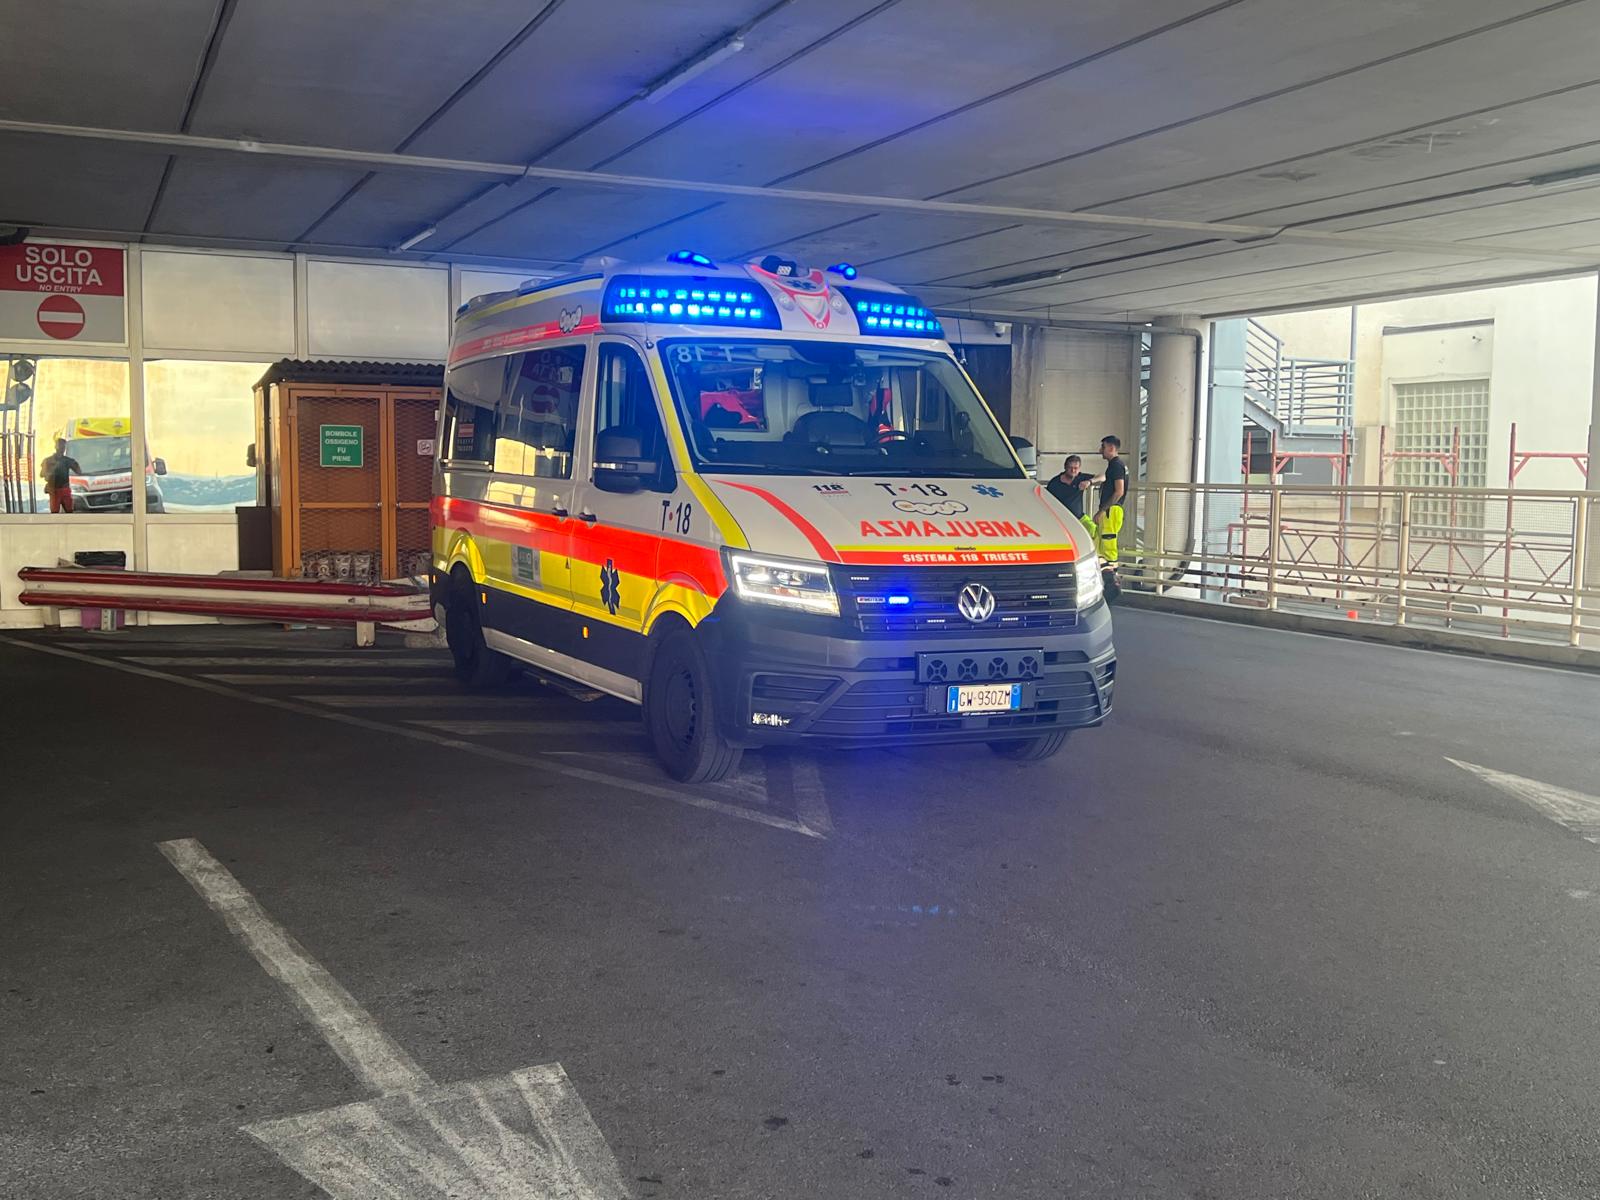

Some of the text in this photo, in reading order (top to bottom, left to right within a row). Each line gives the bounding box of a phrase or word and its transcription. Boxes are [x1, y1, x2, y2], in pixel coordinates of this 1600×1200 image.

[25, 246, 93, 267] SOLO
[16, 264, 103, 286] USCITA
[39, 284, 82, 293] NO ENTRY
[811, 484, 845, 492] 118
[902, 552, 1029, 563] SISTEMA 118 TRIESTE
